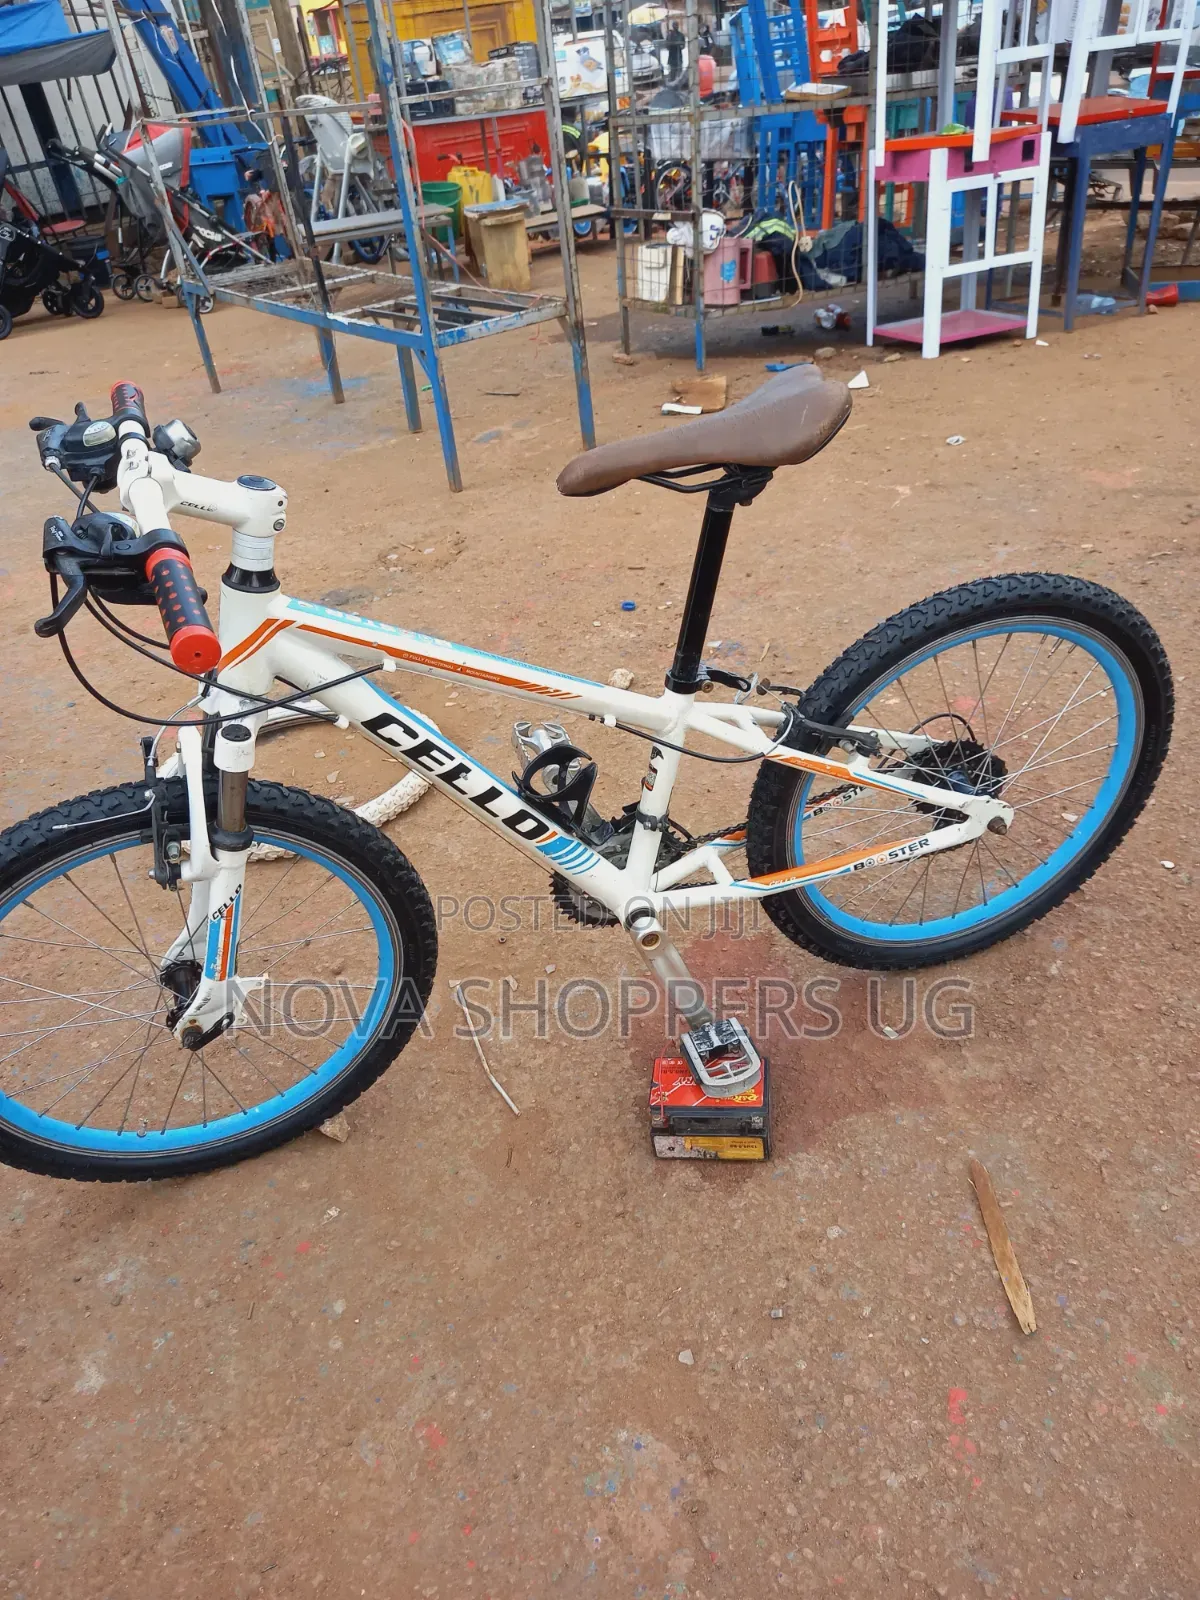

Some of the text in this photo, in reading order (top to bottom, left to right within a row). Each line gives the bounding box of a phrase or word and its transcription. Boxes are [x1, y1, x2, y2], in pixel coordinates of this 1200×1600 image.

[361, 712, 550, 841] CELLO
[853, 838, 929, 870] BOOSTER
[212, 884, 241, 920] CELLO
